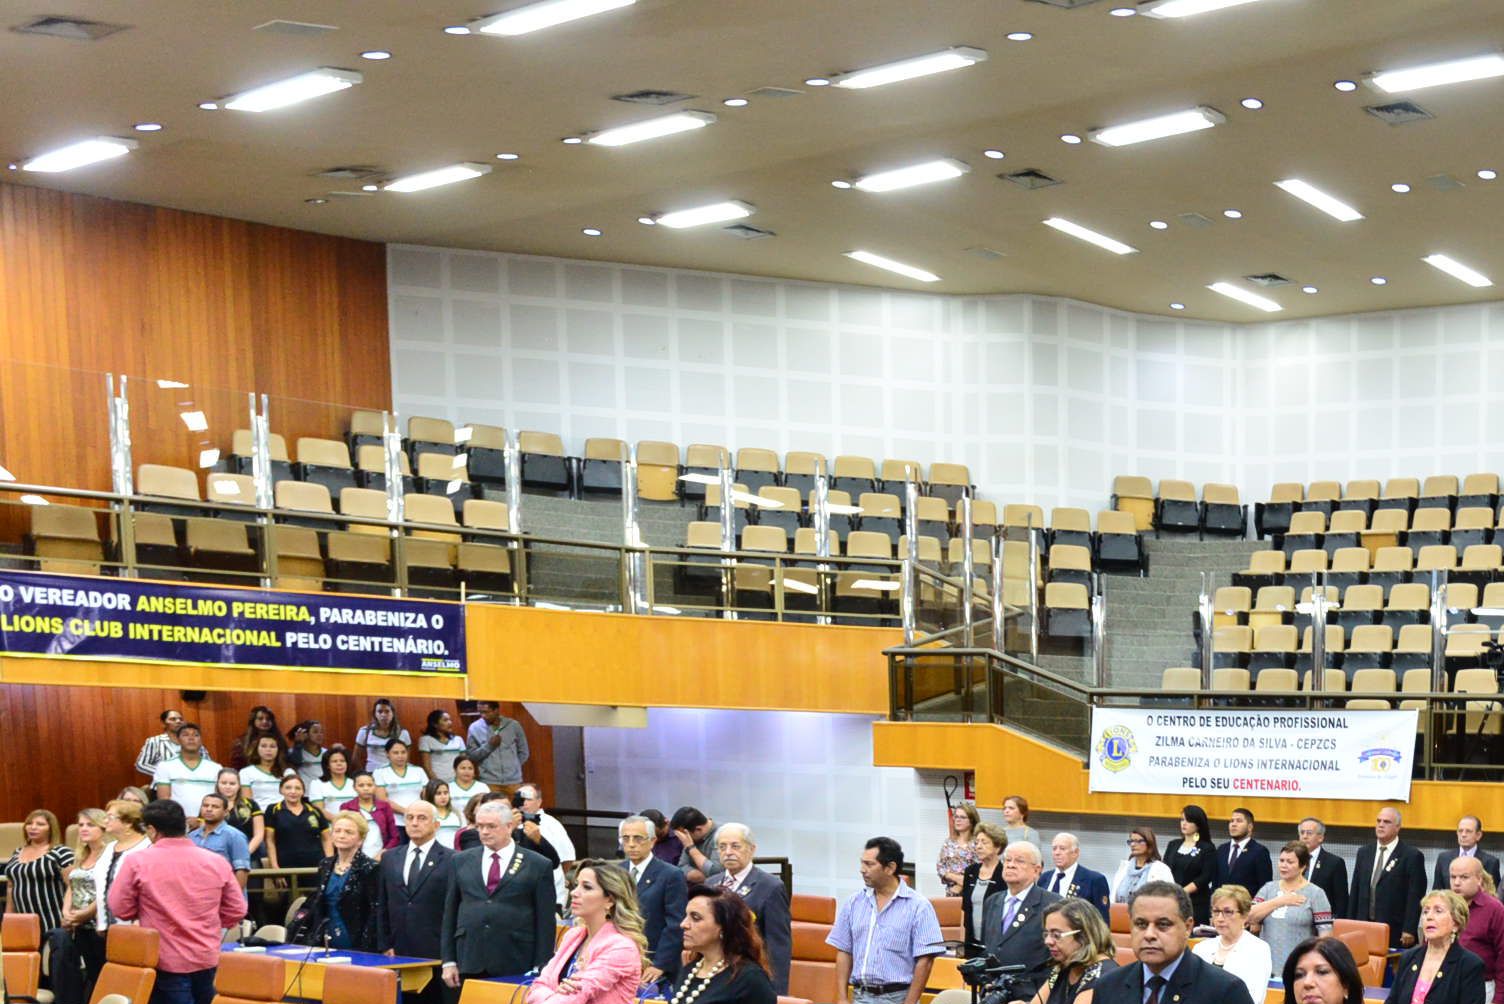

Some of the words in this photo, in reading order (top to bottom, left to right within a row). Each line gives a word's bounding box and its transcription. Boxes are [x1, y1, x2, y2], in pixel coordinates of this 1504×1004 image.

[0, 585, 14, 602] O
[19, 586, 131, 610] VEREADOR
[136, 595, 227, 617] ANSELMO
[232, 602, 315, 625] PEREIRA,
[320, 607, 428, 628] PARABENIZA
[432, 615, 443, 629] O
[1, 615, 64, 634] LIONS
[69, 619, 123, 638] CLUB
[129, 623, 281, 647] INTERNACIONAL
[286, 632, 332, 649] PELO
[336, 634, 449, 655] CENTENÁRIO.
[421, 660, 460, 669] ANSELMO
[1146, 715, 1153, 726] O
[1157, 715, 1196, 727] CENTRO
[1199, 716, 1212, 727] DE
[1215, 714, 1270, 731] EDUCAÇÃO
[1273, 717, 1349, 729] PROFISSIONAL
[1155, 735, 1185, 747] ZILMA
[1188, 736, 1239, 748] CARNEIRO
[1243, 737, 1255, 748] DA
[1259, 737, 1287, 749] SILVA
[1296, 738, 1337, 750] CEPZCS
[1149, 756, 1210, 768] PARABENIZA
[1213, 758, 1220, 768] O
[1224, 758, 1254, 769] LIONS
[1257, 759, 1340, 771] INTERNACIONAL
[1182, 777, 1207, 788] PELO
[1210, 778, 1230, 789] SEU
[1233, 778, 1301, 791] CENTENARIO.
